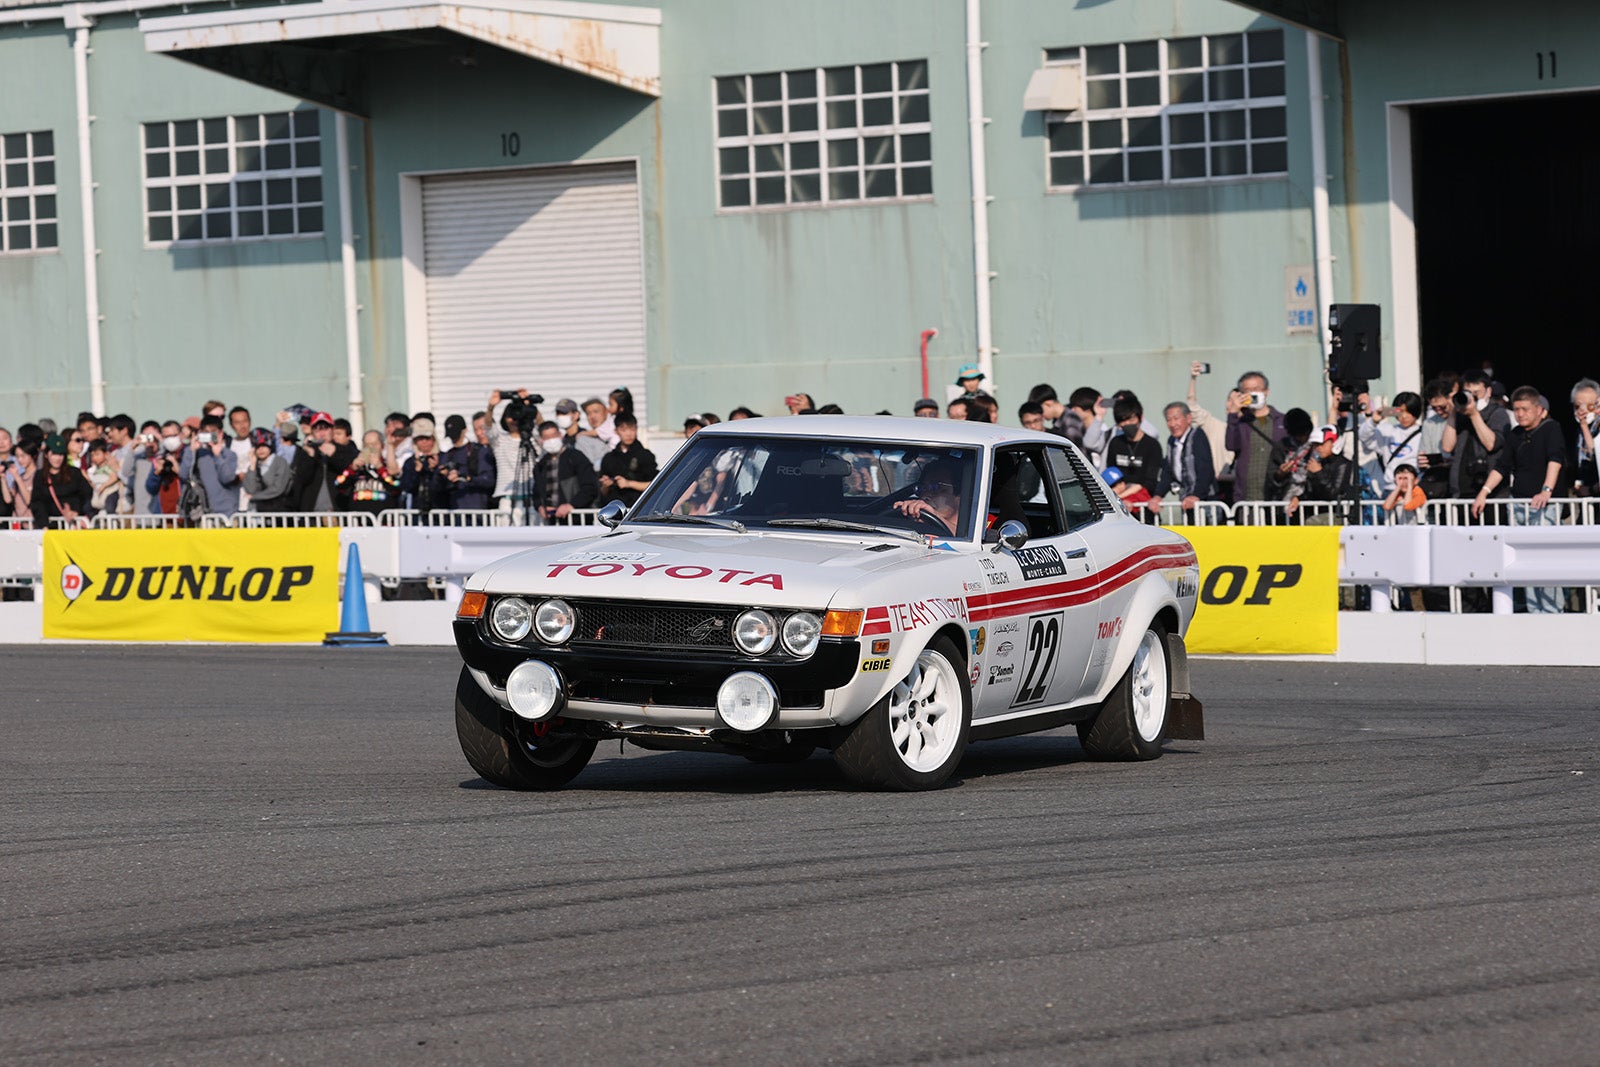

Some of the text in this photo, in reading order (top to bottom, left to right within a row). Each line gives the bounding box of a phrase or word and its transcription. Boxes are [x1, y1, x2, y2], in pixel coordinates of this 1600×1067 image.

[1536, 51, 1556, 80] 11
[500, 131, 521, 157] 10
[1012, 546, 1060, 567] LE CASINO
[95, 565, 314, 602] DUNLOP
[546, 562, 785, 591] TOYOTA
[889, 600, 938, 632] TEAM
[1097, 616, 1123, 641] TOM'S
[1014, 617, 1059, 704] 22
